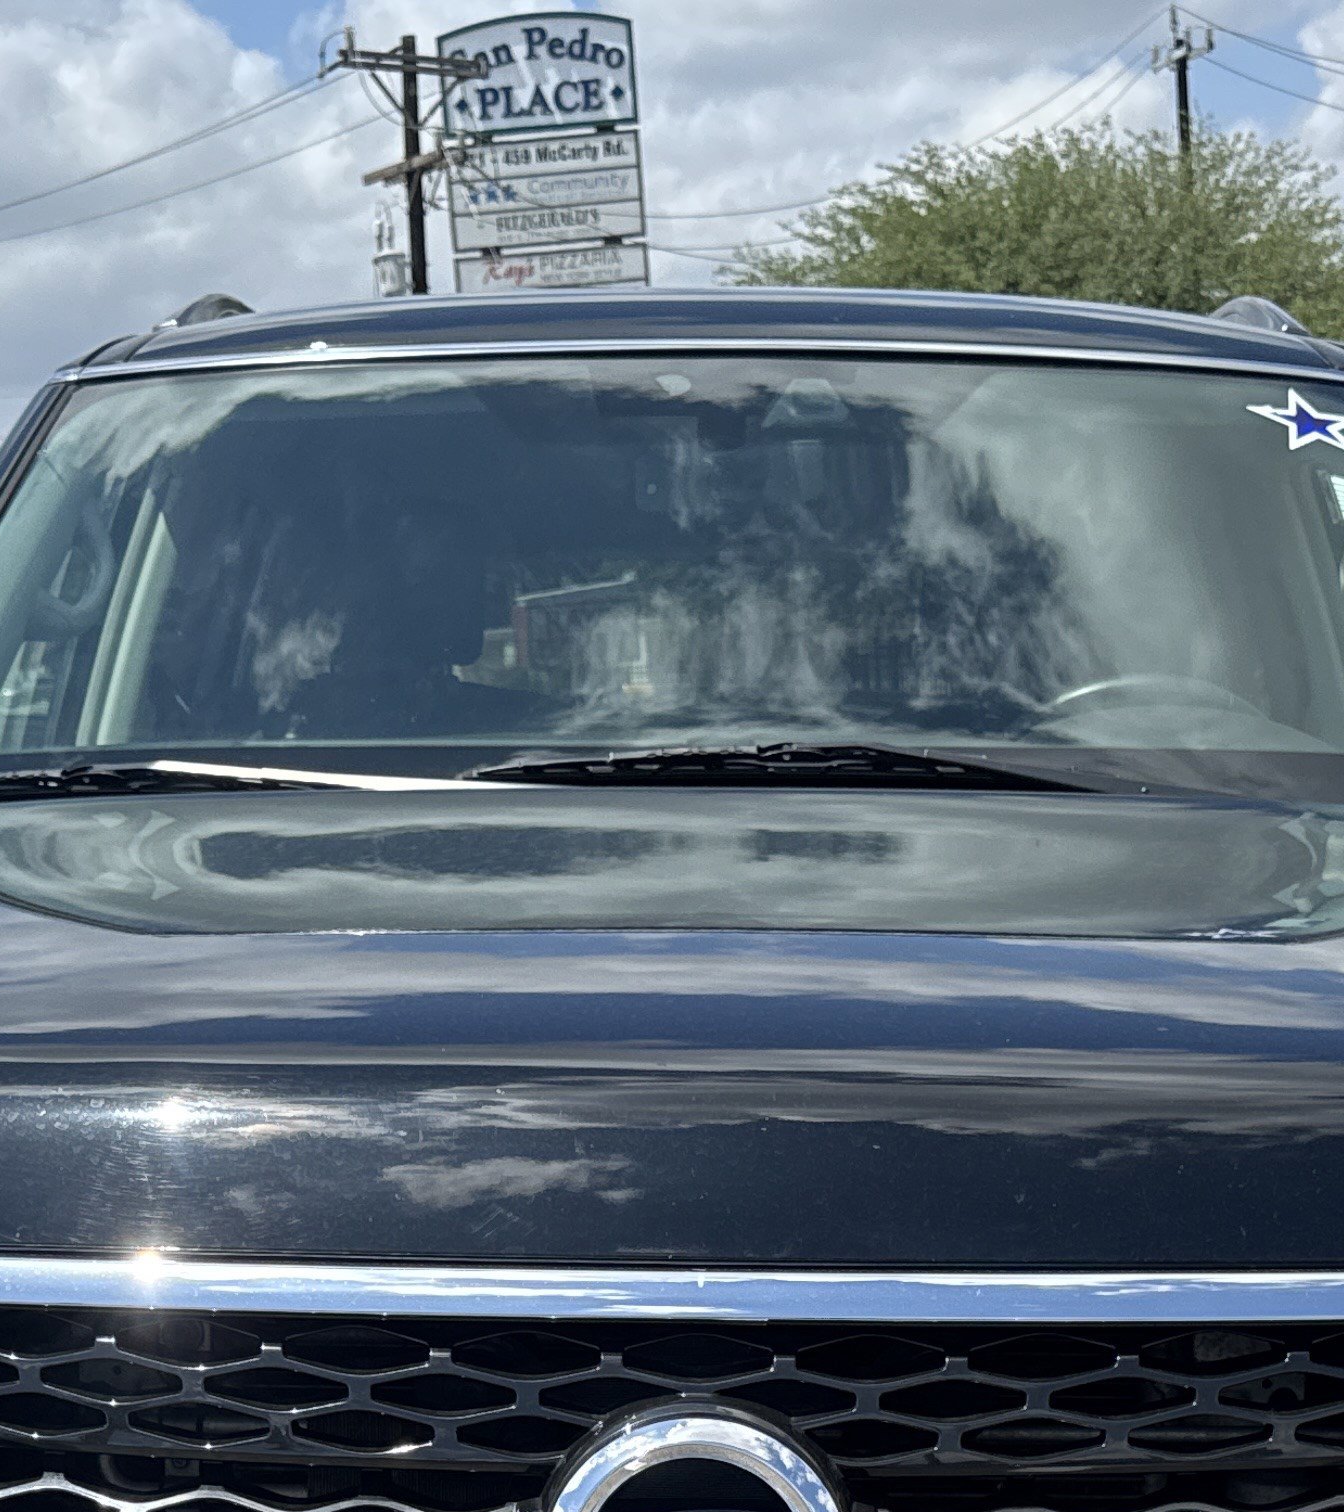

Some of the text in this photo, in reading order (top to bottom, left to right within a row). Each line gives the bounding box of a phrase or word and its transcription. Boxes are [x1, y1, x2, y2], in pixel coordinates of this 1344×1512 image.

[521, 26, 626, 70] Pedro
[475, 78, 605, 120] PLACE
[535, 142, 600, 163] McCarty
